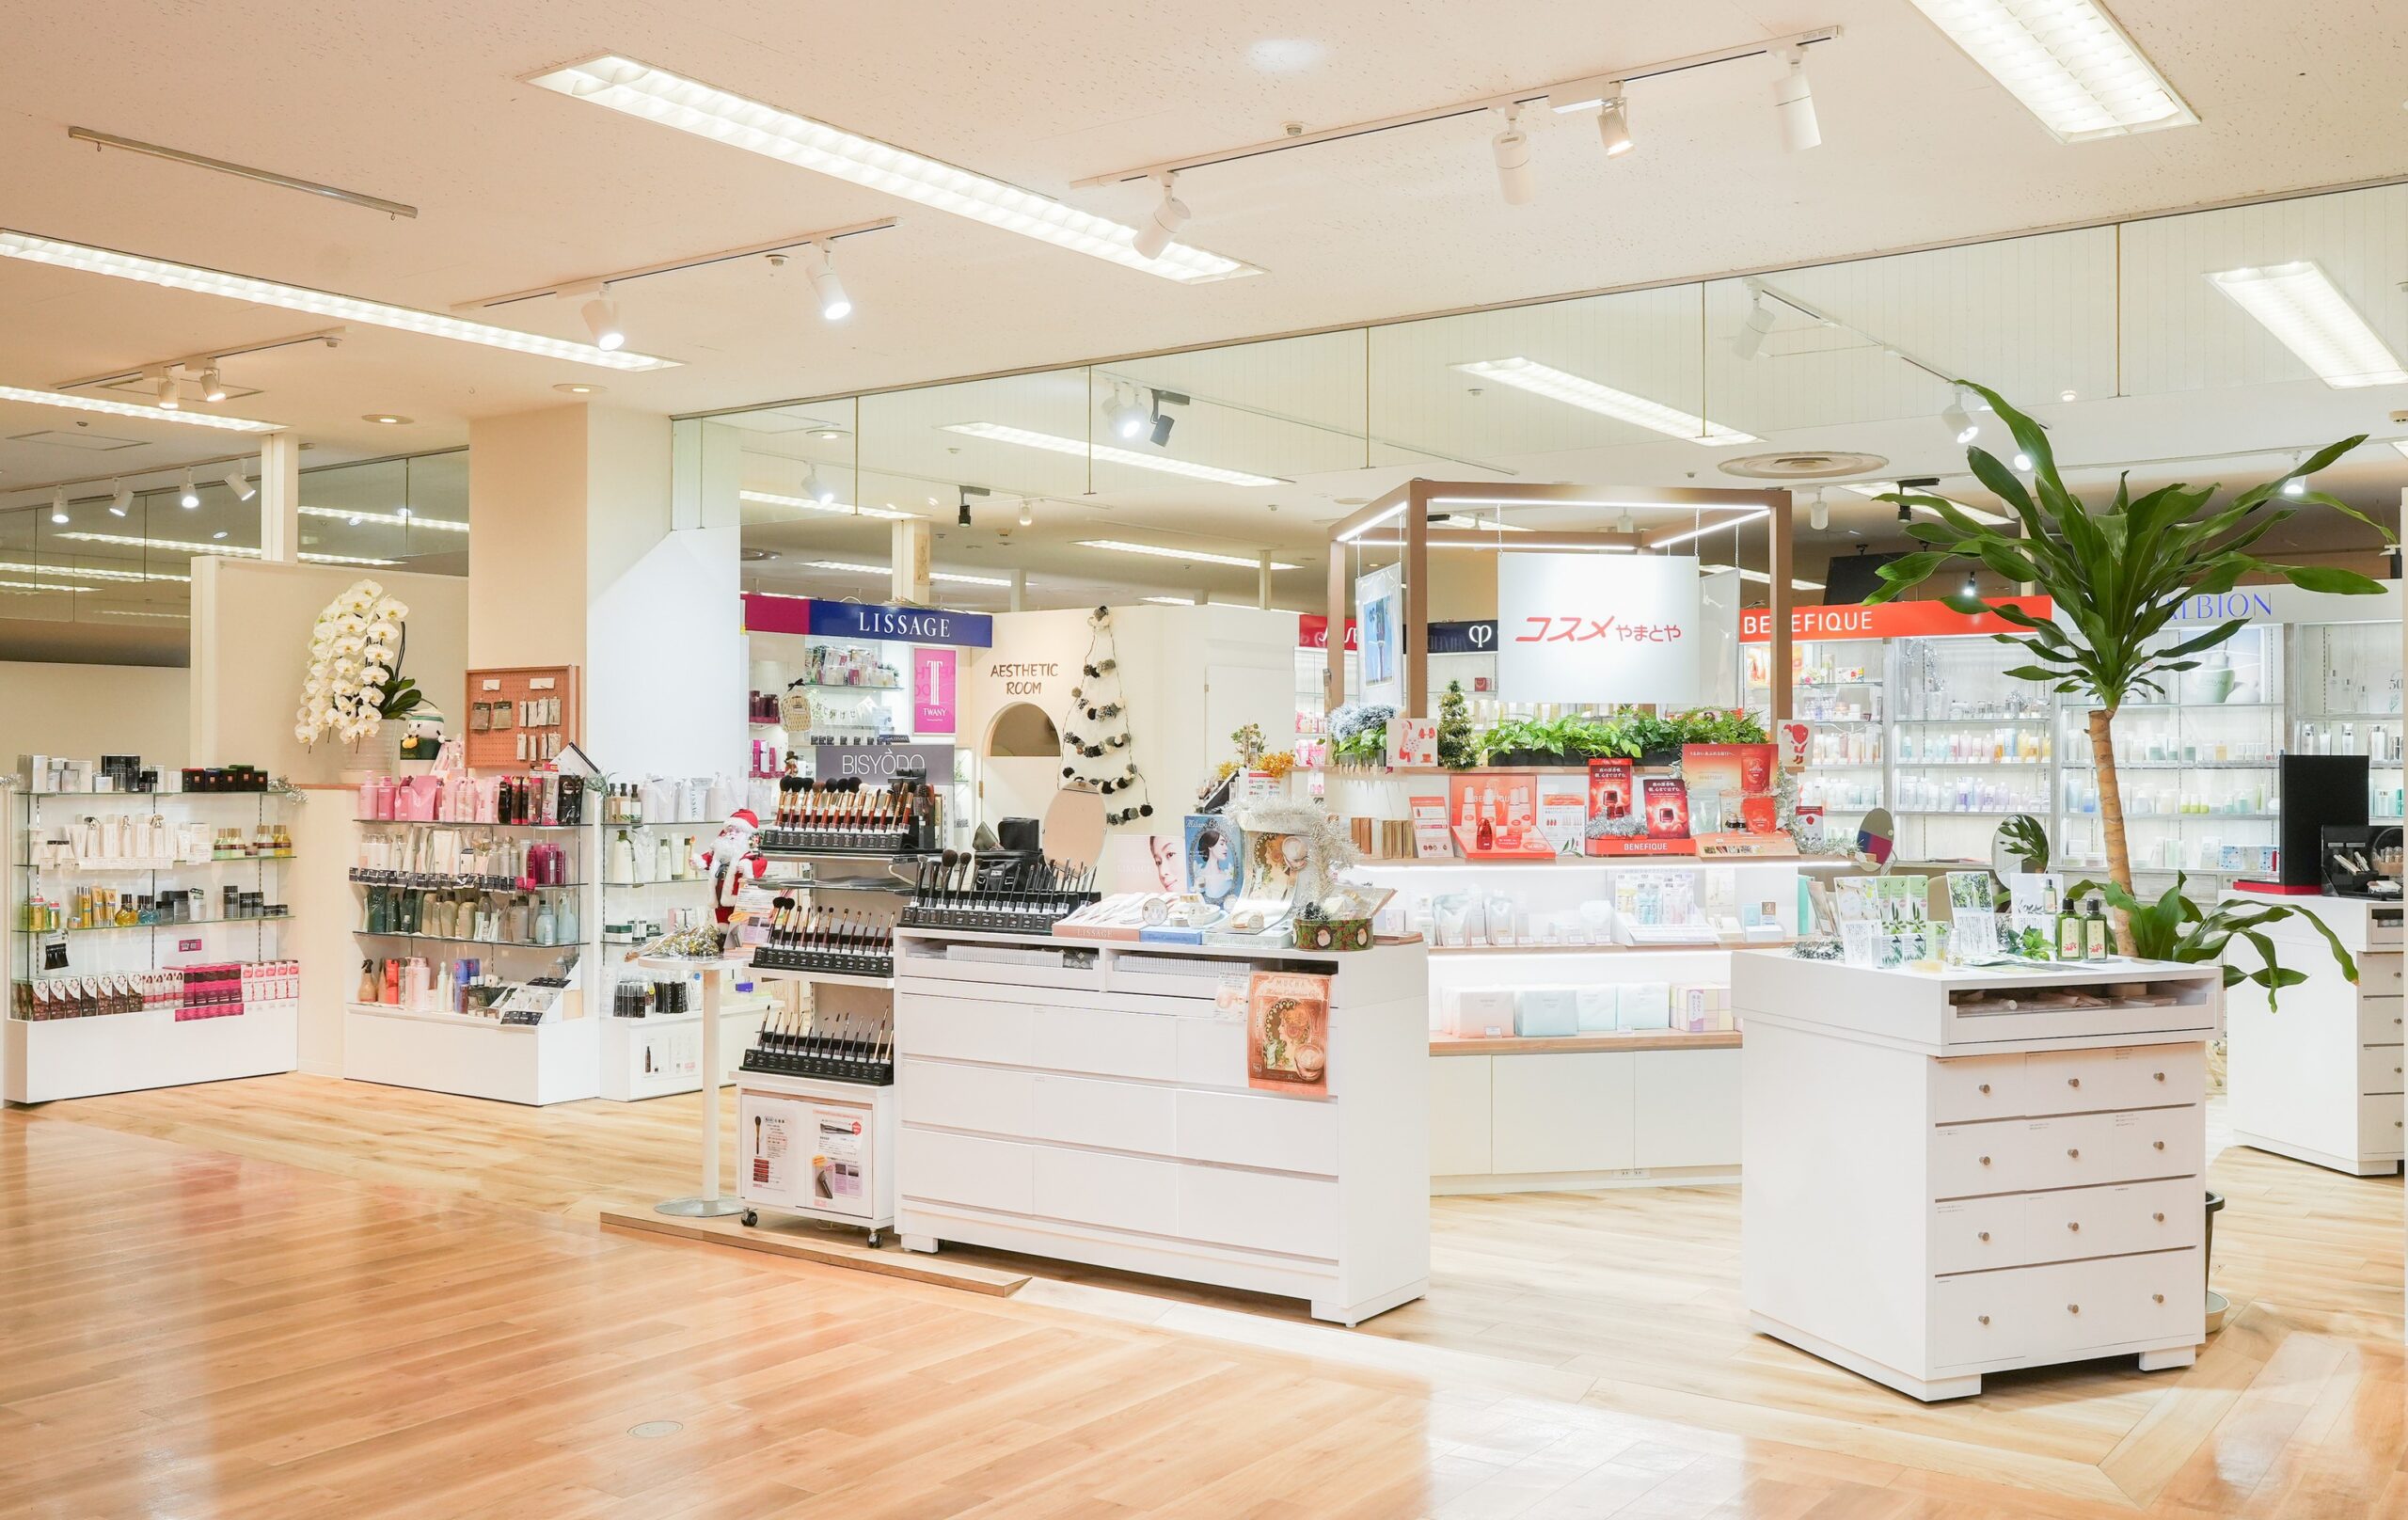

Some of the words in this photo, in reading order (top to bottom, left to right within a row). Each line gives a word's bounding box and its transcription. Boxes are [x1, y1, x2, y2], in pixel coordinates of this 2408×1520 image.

[859, 611, 950, 638] LISSAGE
[1743, 611, 1874, 635] BEEFIQUE
[990, 663, 1058, 677] AESTHETIC
[1006, 681, 1041, 695] ROOM
[923, 707, 948, 717] TWANY
[1077, 928, 1113, 938] LISSAGE
